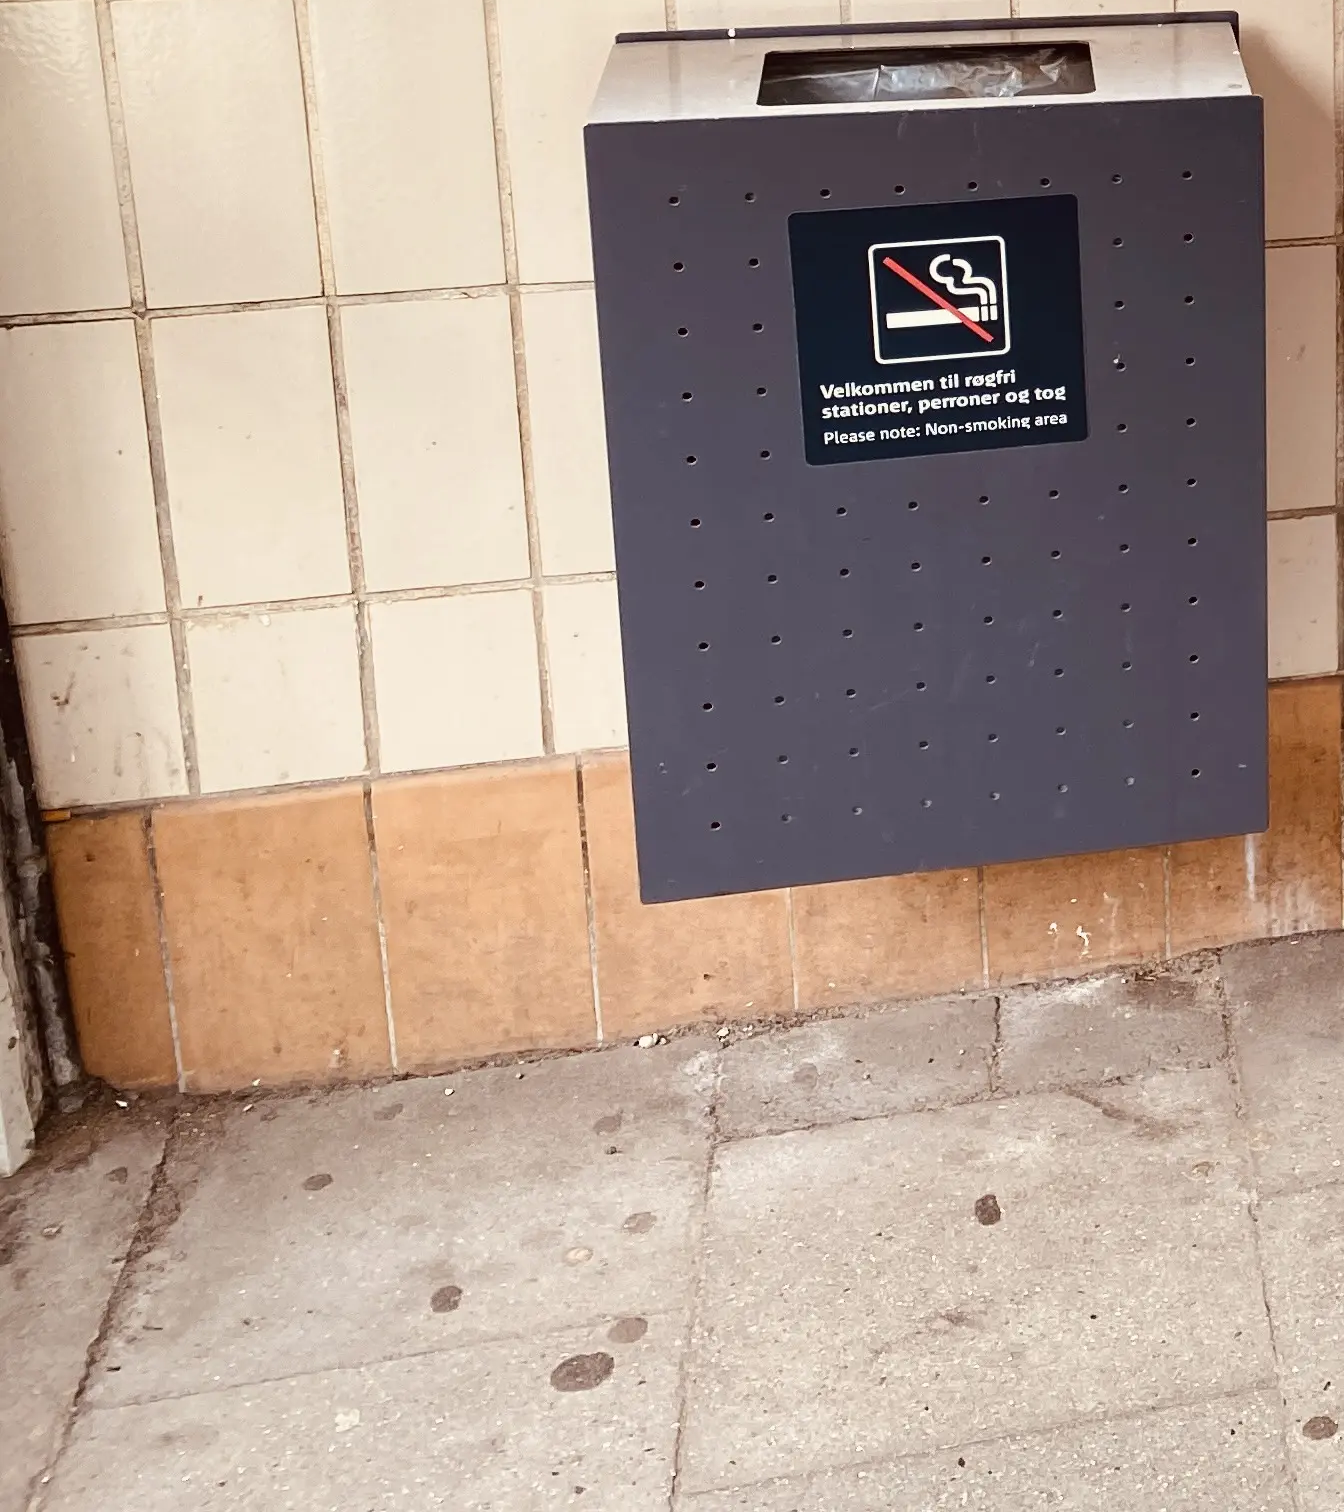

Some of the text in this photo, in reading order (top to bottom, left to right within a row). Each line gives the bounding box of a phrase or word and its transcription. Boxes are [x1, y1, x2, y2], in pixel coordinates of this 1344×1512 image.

[820, 369, 1016, 399] Velkommen til røgfri
[821, 385, 1066, 420] stationer, perroner og tog
[823, 413, 1068, 445] Please note: Non-smoking area
